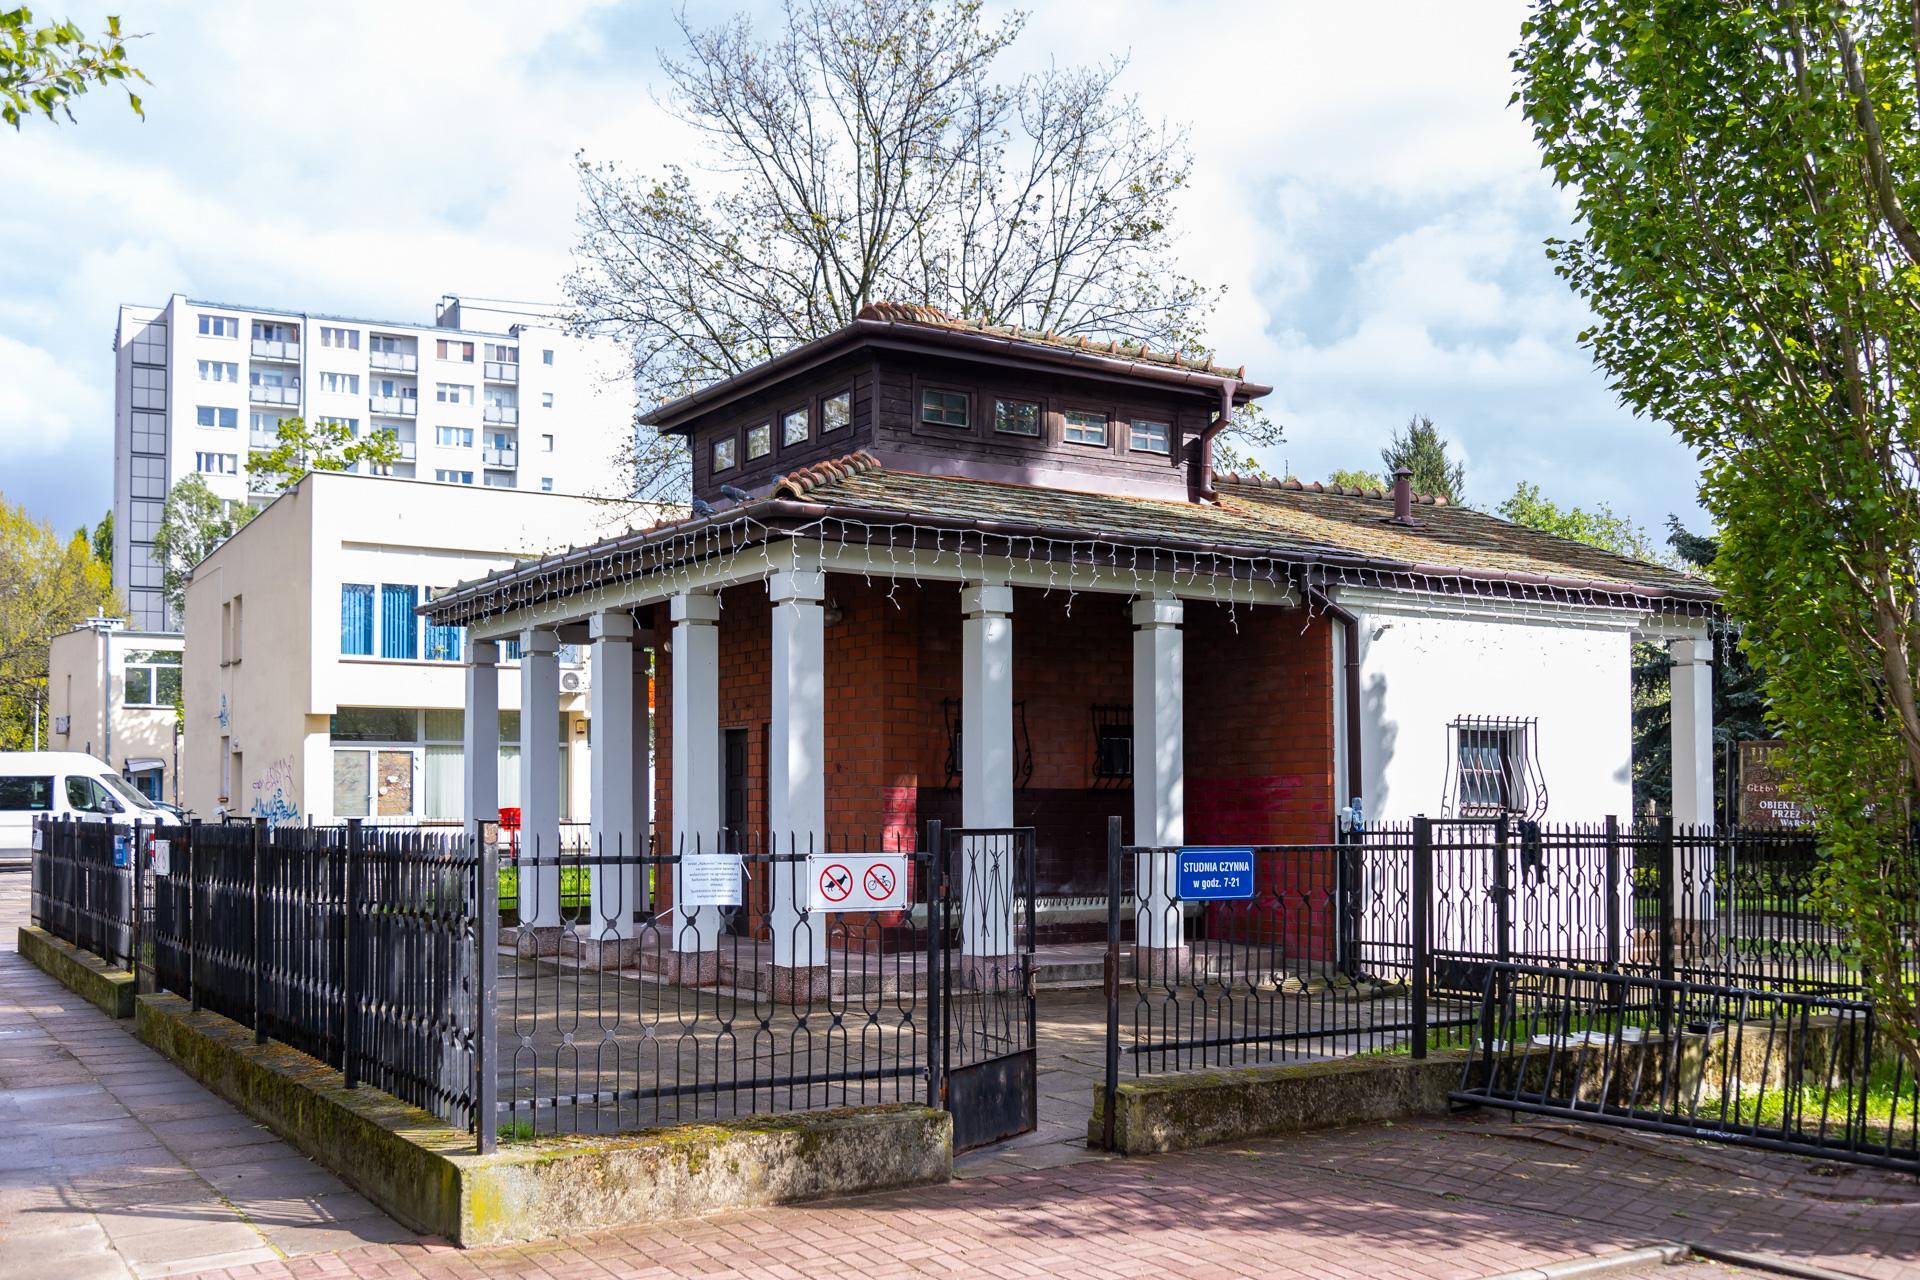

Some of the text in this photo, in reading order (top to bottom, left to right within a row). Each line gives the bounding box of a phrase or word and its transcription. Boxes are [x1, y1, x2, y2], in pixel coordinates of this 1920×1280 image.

[1759, 800, 1795, 809] OBIEKT
[1771, 809, 1801, 819] PRZEZ
[1183, 861, 1250, 873] STUDNIA CZYNNA
[1193, 877, 1240, 890] w godz. 7-21
